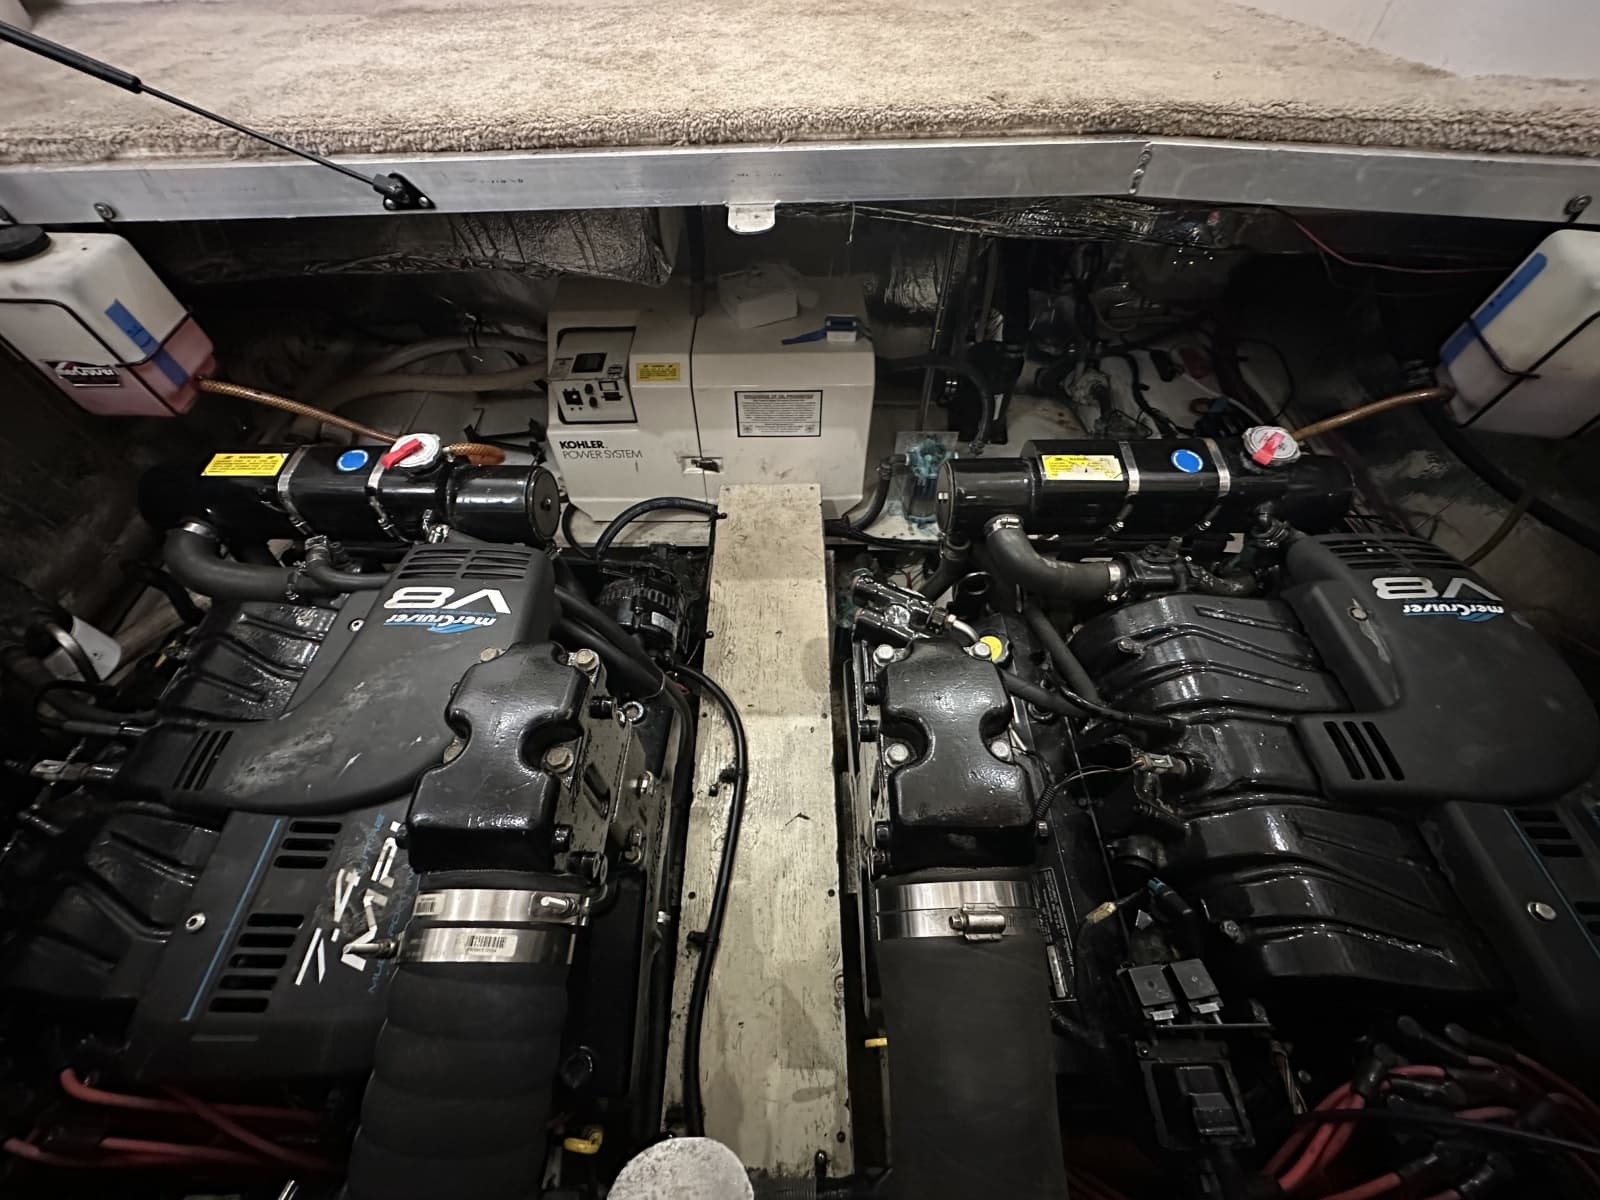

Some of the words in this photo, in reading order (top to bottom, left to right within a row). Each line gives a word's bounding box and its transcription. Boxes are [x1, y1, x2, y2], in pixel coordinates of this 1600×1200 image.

[562, 450, 602, 459] POWER
[604, 450, 643, 458] SYSTEM
[383, 586, 511, 614] V8
[1372, 577, 1503, 600] V8
